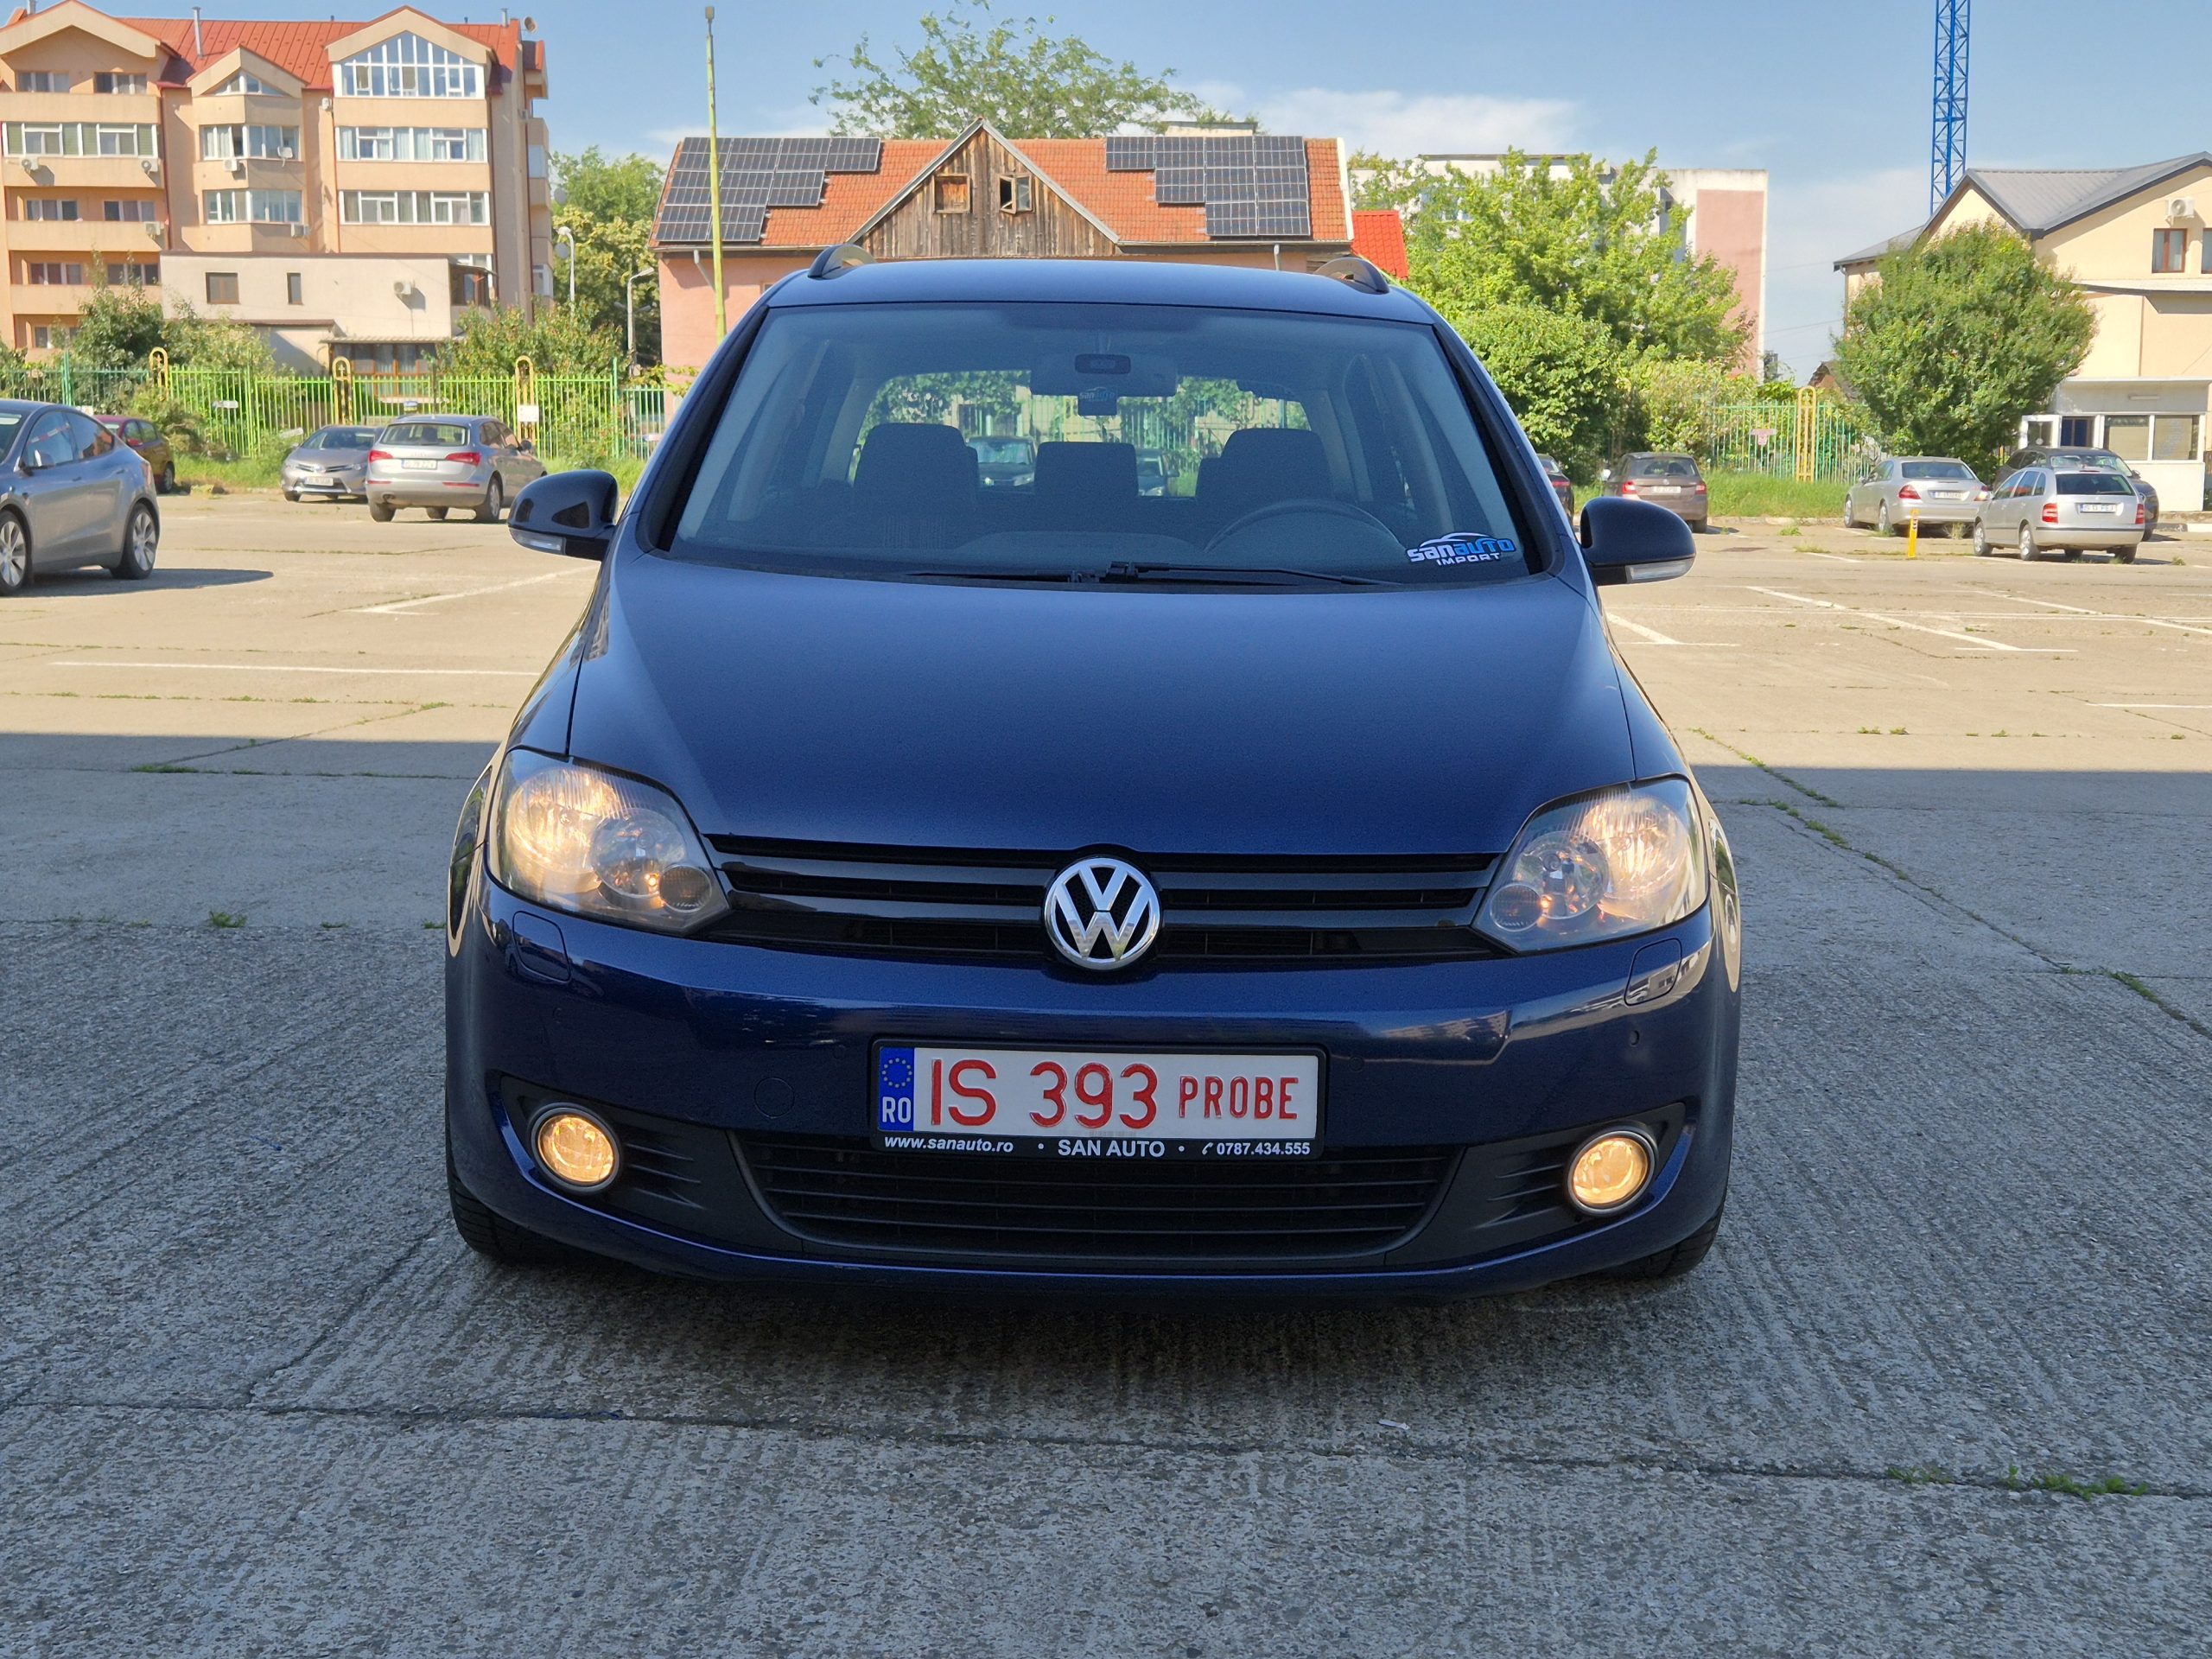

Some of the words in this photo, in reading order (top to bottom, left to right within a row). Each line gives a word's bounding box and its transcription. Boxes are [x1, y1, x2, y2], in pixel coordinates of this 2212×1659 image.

[1436, 552, 1500, 567] IMPORT
[931, 1058, 997, 1127] IS
[1029, 1061, 1158, 1128] 393
[1179, 1076, 1299, 1120] PROBE
[882, 1096, 912, 1123] RO
[884, 1135, 1014, 1154] www.sanauto.ro
[1058, 1139, 1101, 1156] SAN
[1106, 1141, 1165, 1157] AUTO
[1217, 1141, 1311, 1155] 0787.434.555
